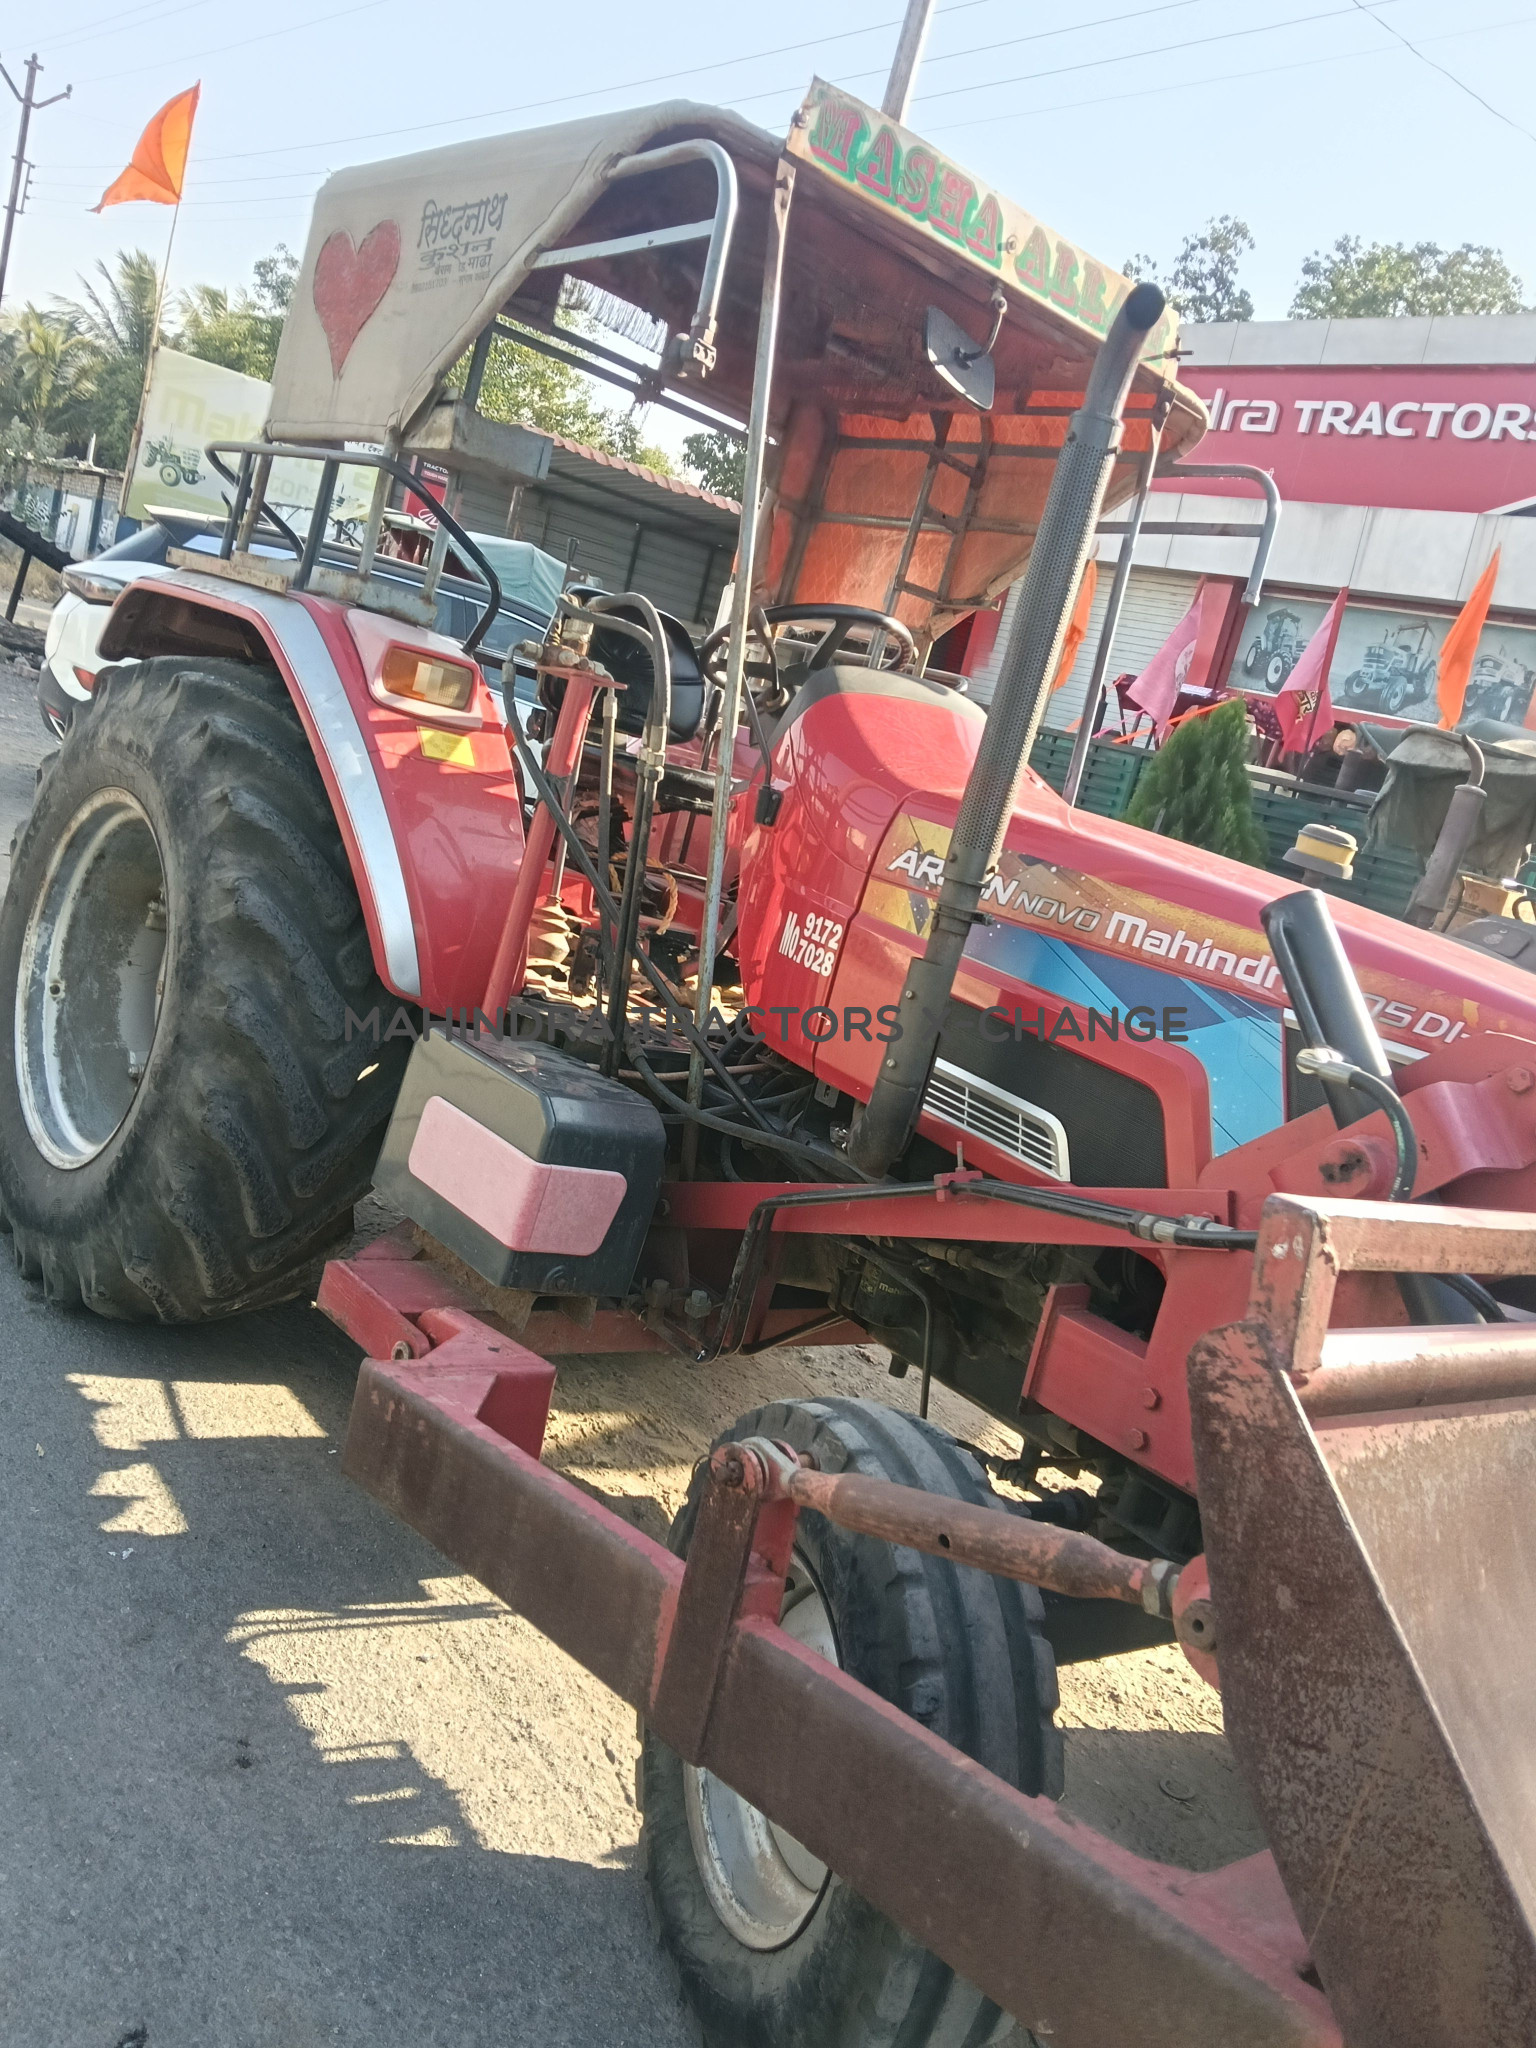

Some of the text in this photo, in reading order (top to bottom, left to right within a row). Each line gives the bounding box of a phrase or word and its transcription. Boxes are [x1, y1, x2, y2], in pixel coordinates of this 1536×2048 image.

[808, 92, 1170, 368] MASHA ALL
[423, 461, 449, 475] TRACTO
[887, 848, 1018, 906] ARN
[1013, 889, 1101, 933] NOVO
[803, 912, 843, 950] 9172
